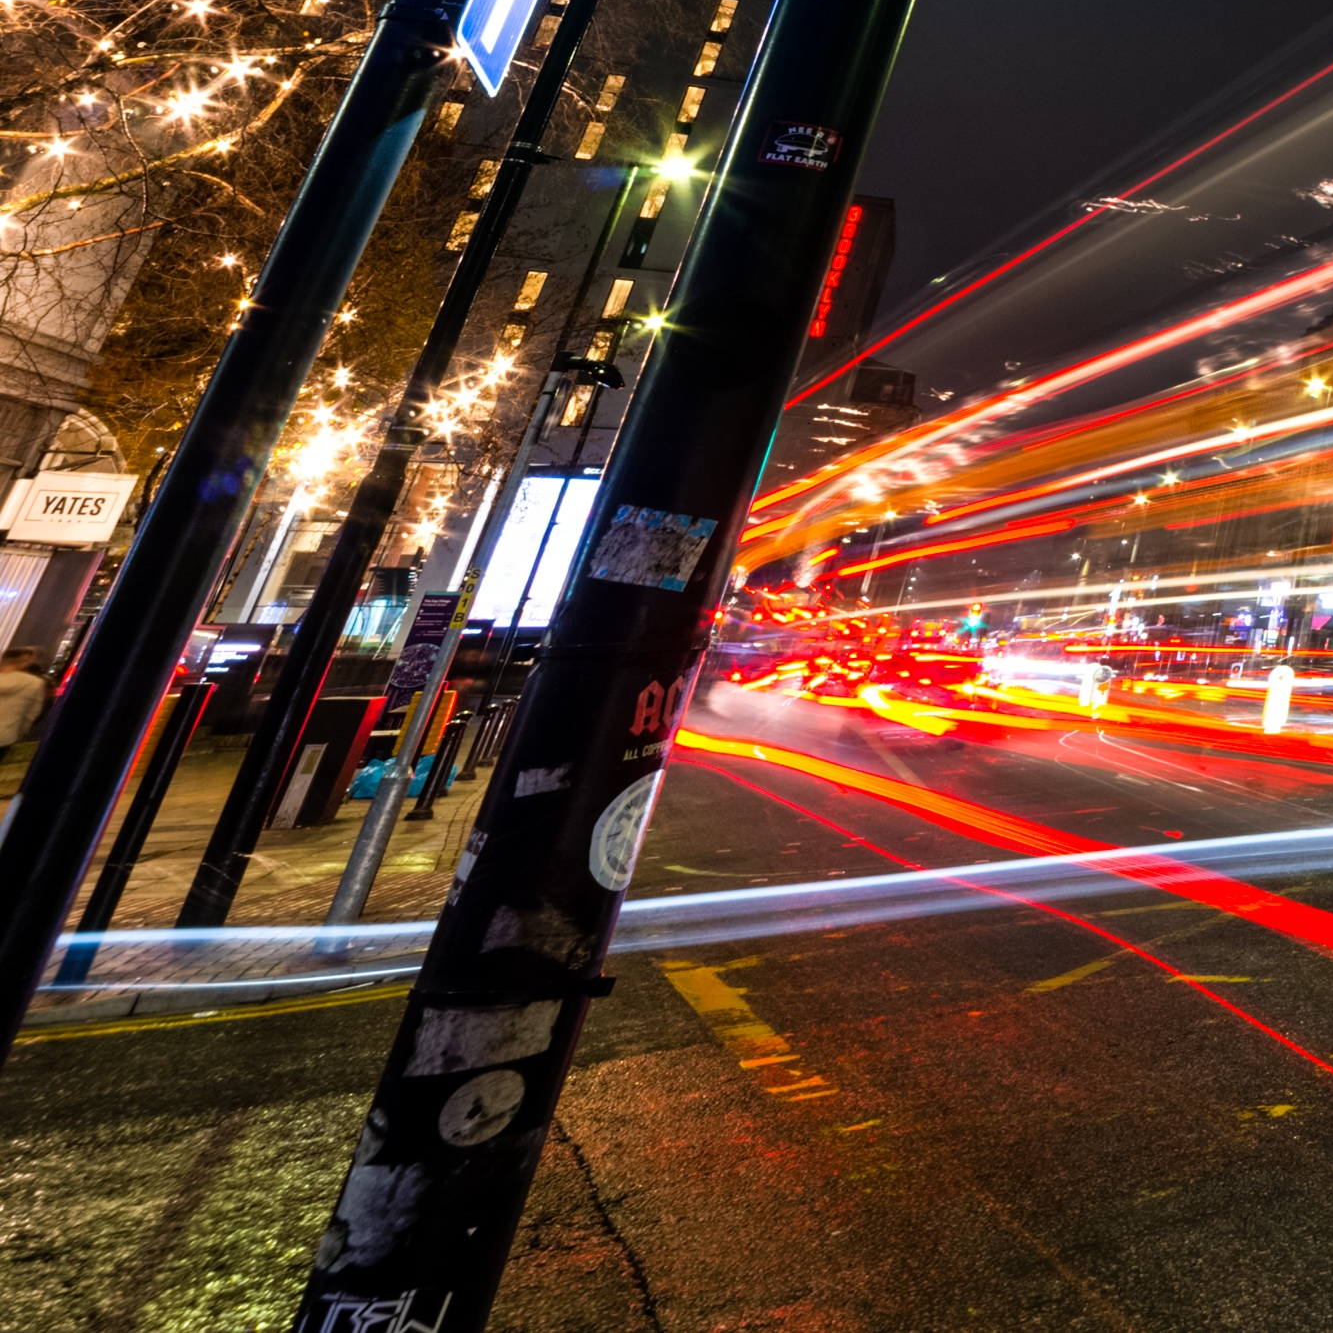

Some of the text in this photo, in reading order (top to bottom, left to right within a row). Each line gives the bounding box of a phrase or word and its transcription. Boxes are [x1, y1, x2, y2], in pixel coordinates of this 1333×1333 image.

[765, 152, 829, 169] FLAT EARTH
[42, 495, 106, 516] YATES
[622, 749, 639, 762] ALL
